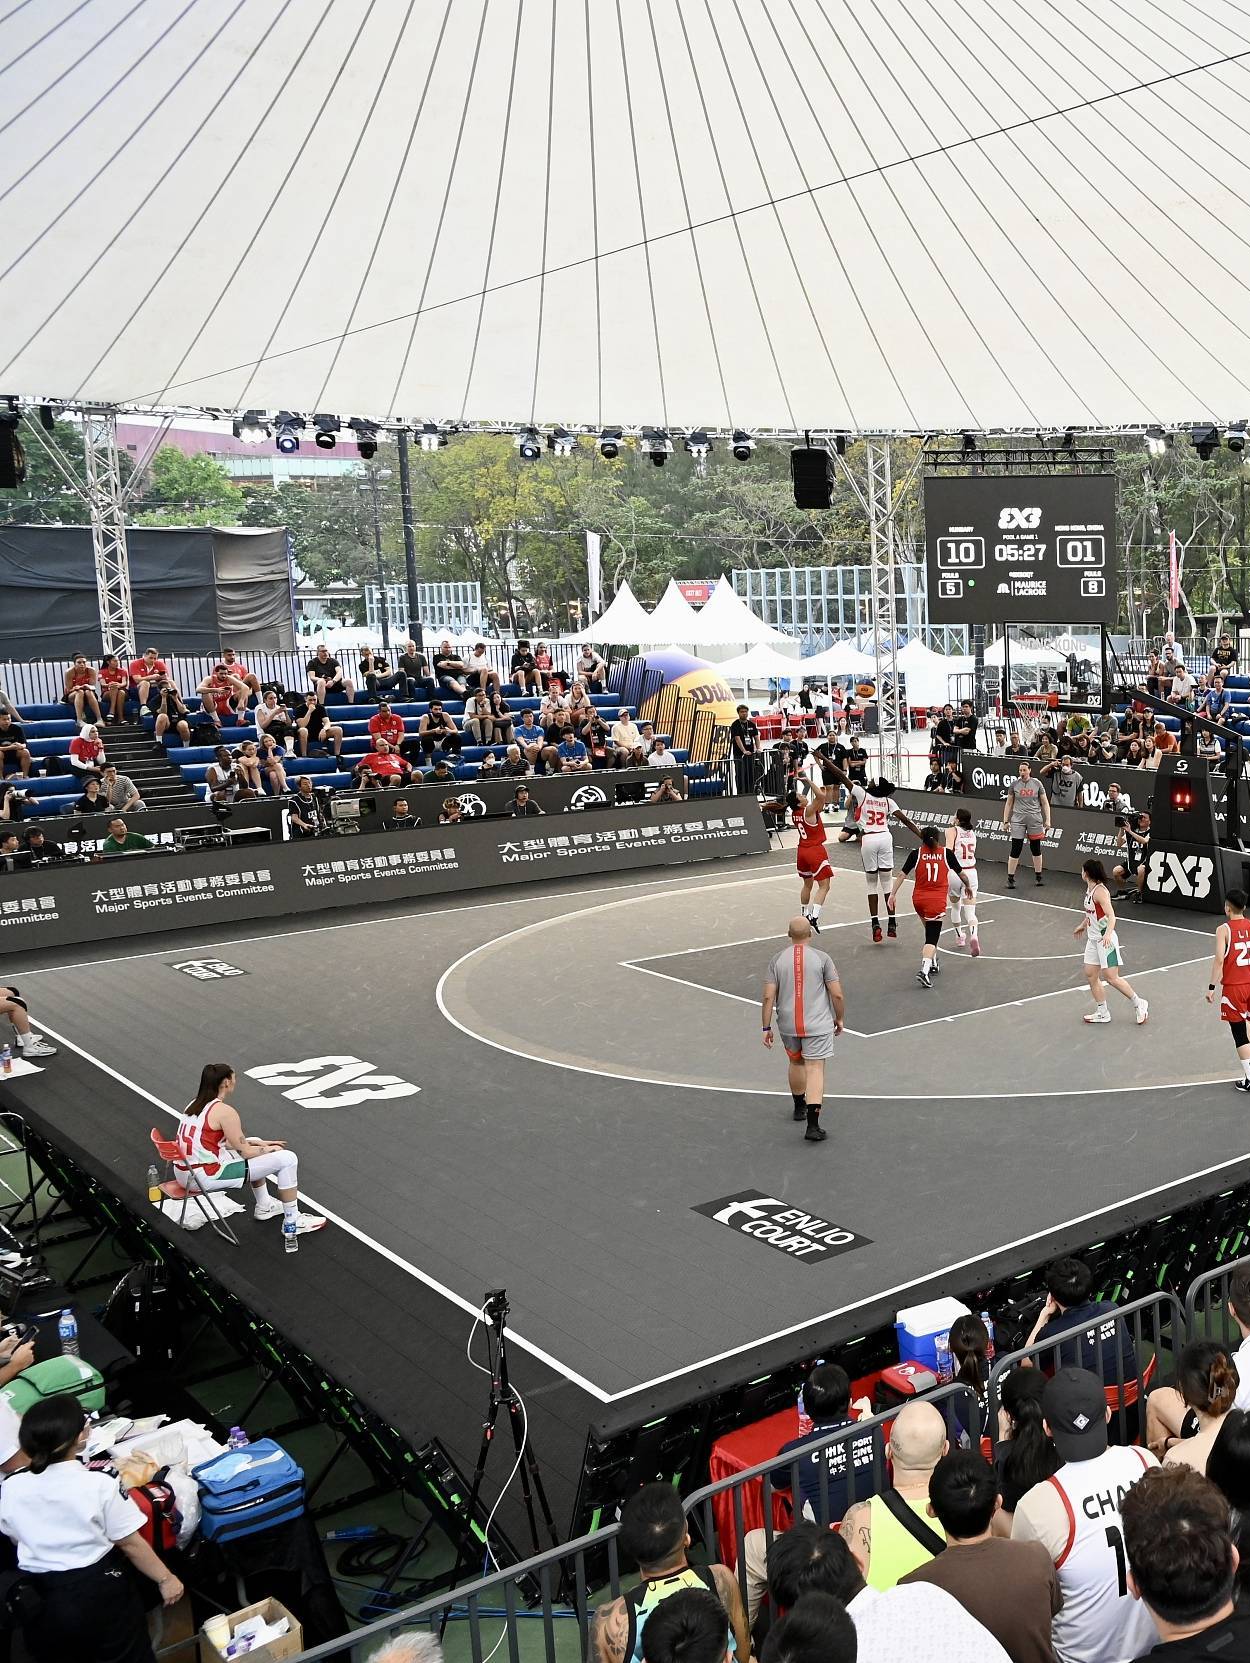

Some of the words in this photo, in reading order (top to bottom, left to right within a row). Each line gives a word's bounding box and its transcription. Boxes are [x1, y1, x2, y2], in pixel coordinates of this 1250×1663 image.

[947, 542, 975, 563] 10
[994, 544, 1046, 561] 05:27
[1067, 541, 1096, 562] 01
[946, 582, 956, 594] 5
[1014, 580, 1046, 588] MAURICE
[1088, 580, 1098, 593] 8
[1020, 638, 1050, 650] HONG
[1056, 638, 1086, 652] KONG
[866, 810, 884, 826] 32
[502, 850, 551, 863] Major
[557, 843, 610, 857] Sports
[616, 837, 666, 850] Events
[671, 828, 748, 843] Committee
[990, 832, 1008, 842] Sports
[960, 843, 974, 860] 15
[1076, 844, 1093, 853] Major
[1094, 846, 1115, 856] Sports
[1116, 849, 1129, 858] Eve
[305, 875, 334, 887] Major
[338, 872, 372, 884] Sports
[374, 867, 406, 878] Events
[408, 861, 459, 874] Committee
[926, 863, 939, 882] 11
[1146, 851, 1214, 899] 3X3
[0, 896, 56, 914] 委員會
[96, 901, 130, 914] Major
[134, 896, 172, 910] Sports
[176, 892, 214, 904] Events
[216, 884, 275, 898] Committee
[0, 911, 59, 926] ommittee
[1238, 930, 1248, 938] LI
[771, 1209, 855, 1245] ENLIO
[741, 1220, 827, 1256] COURT
[852, 1436, 872, 1450] PORT
[1083, 1480, 1136, 1519] CHA
